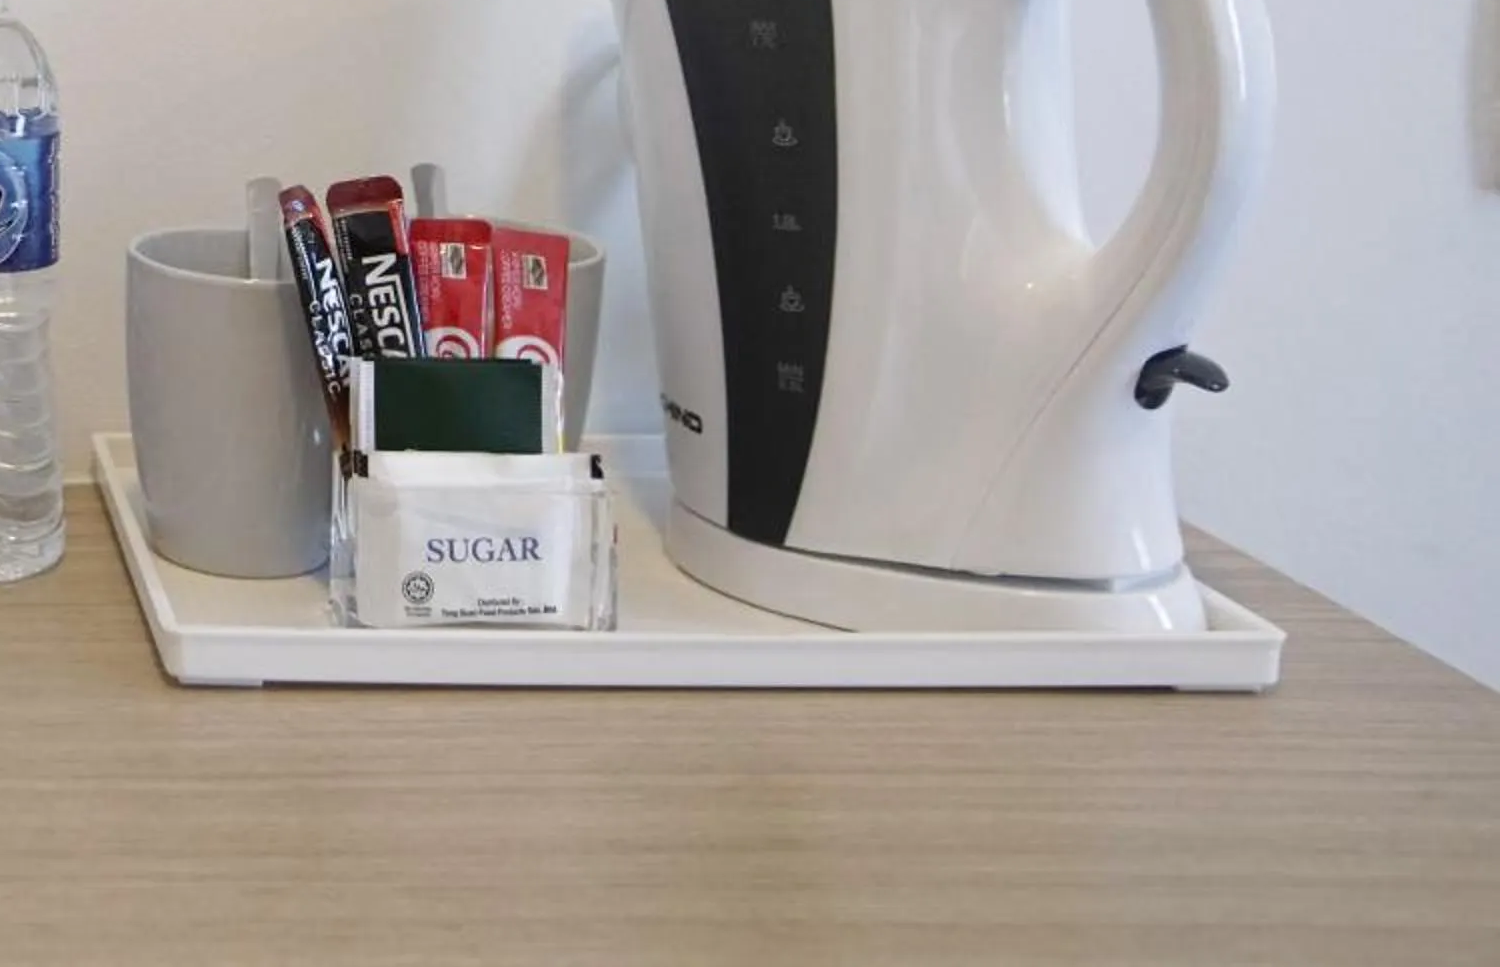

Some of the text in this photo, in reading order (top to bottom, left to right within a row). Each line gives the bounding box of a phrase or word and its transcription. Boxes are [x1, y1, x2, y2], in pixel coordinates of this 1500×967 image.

[308, 299, 342, 400] CLASSIC
[315, 257, 351, 387] NESCA
[426, 536, 543, 564] SUGAR
